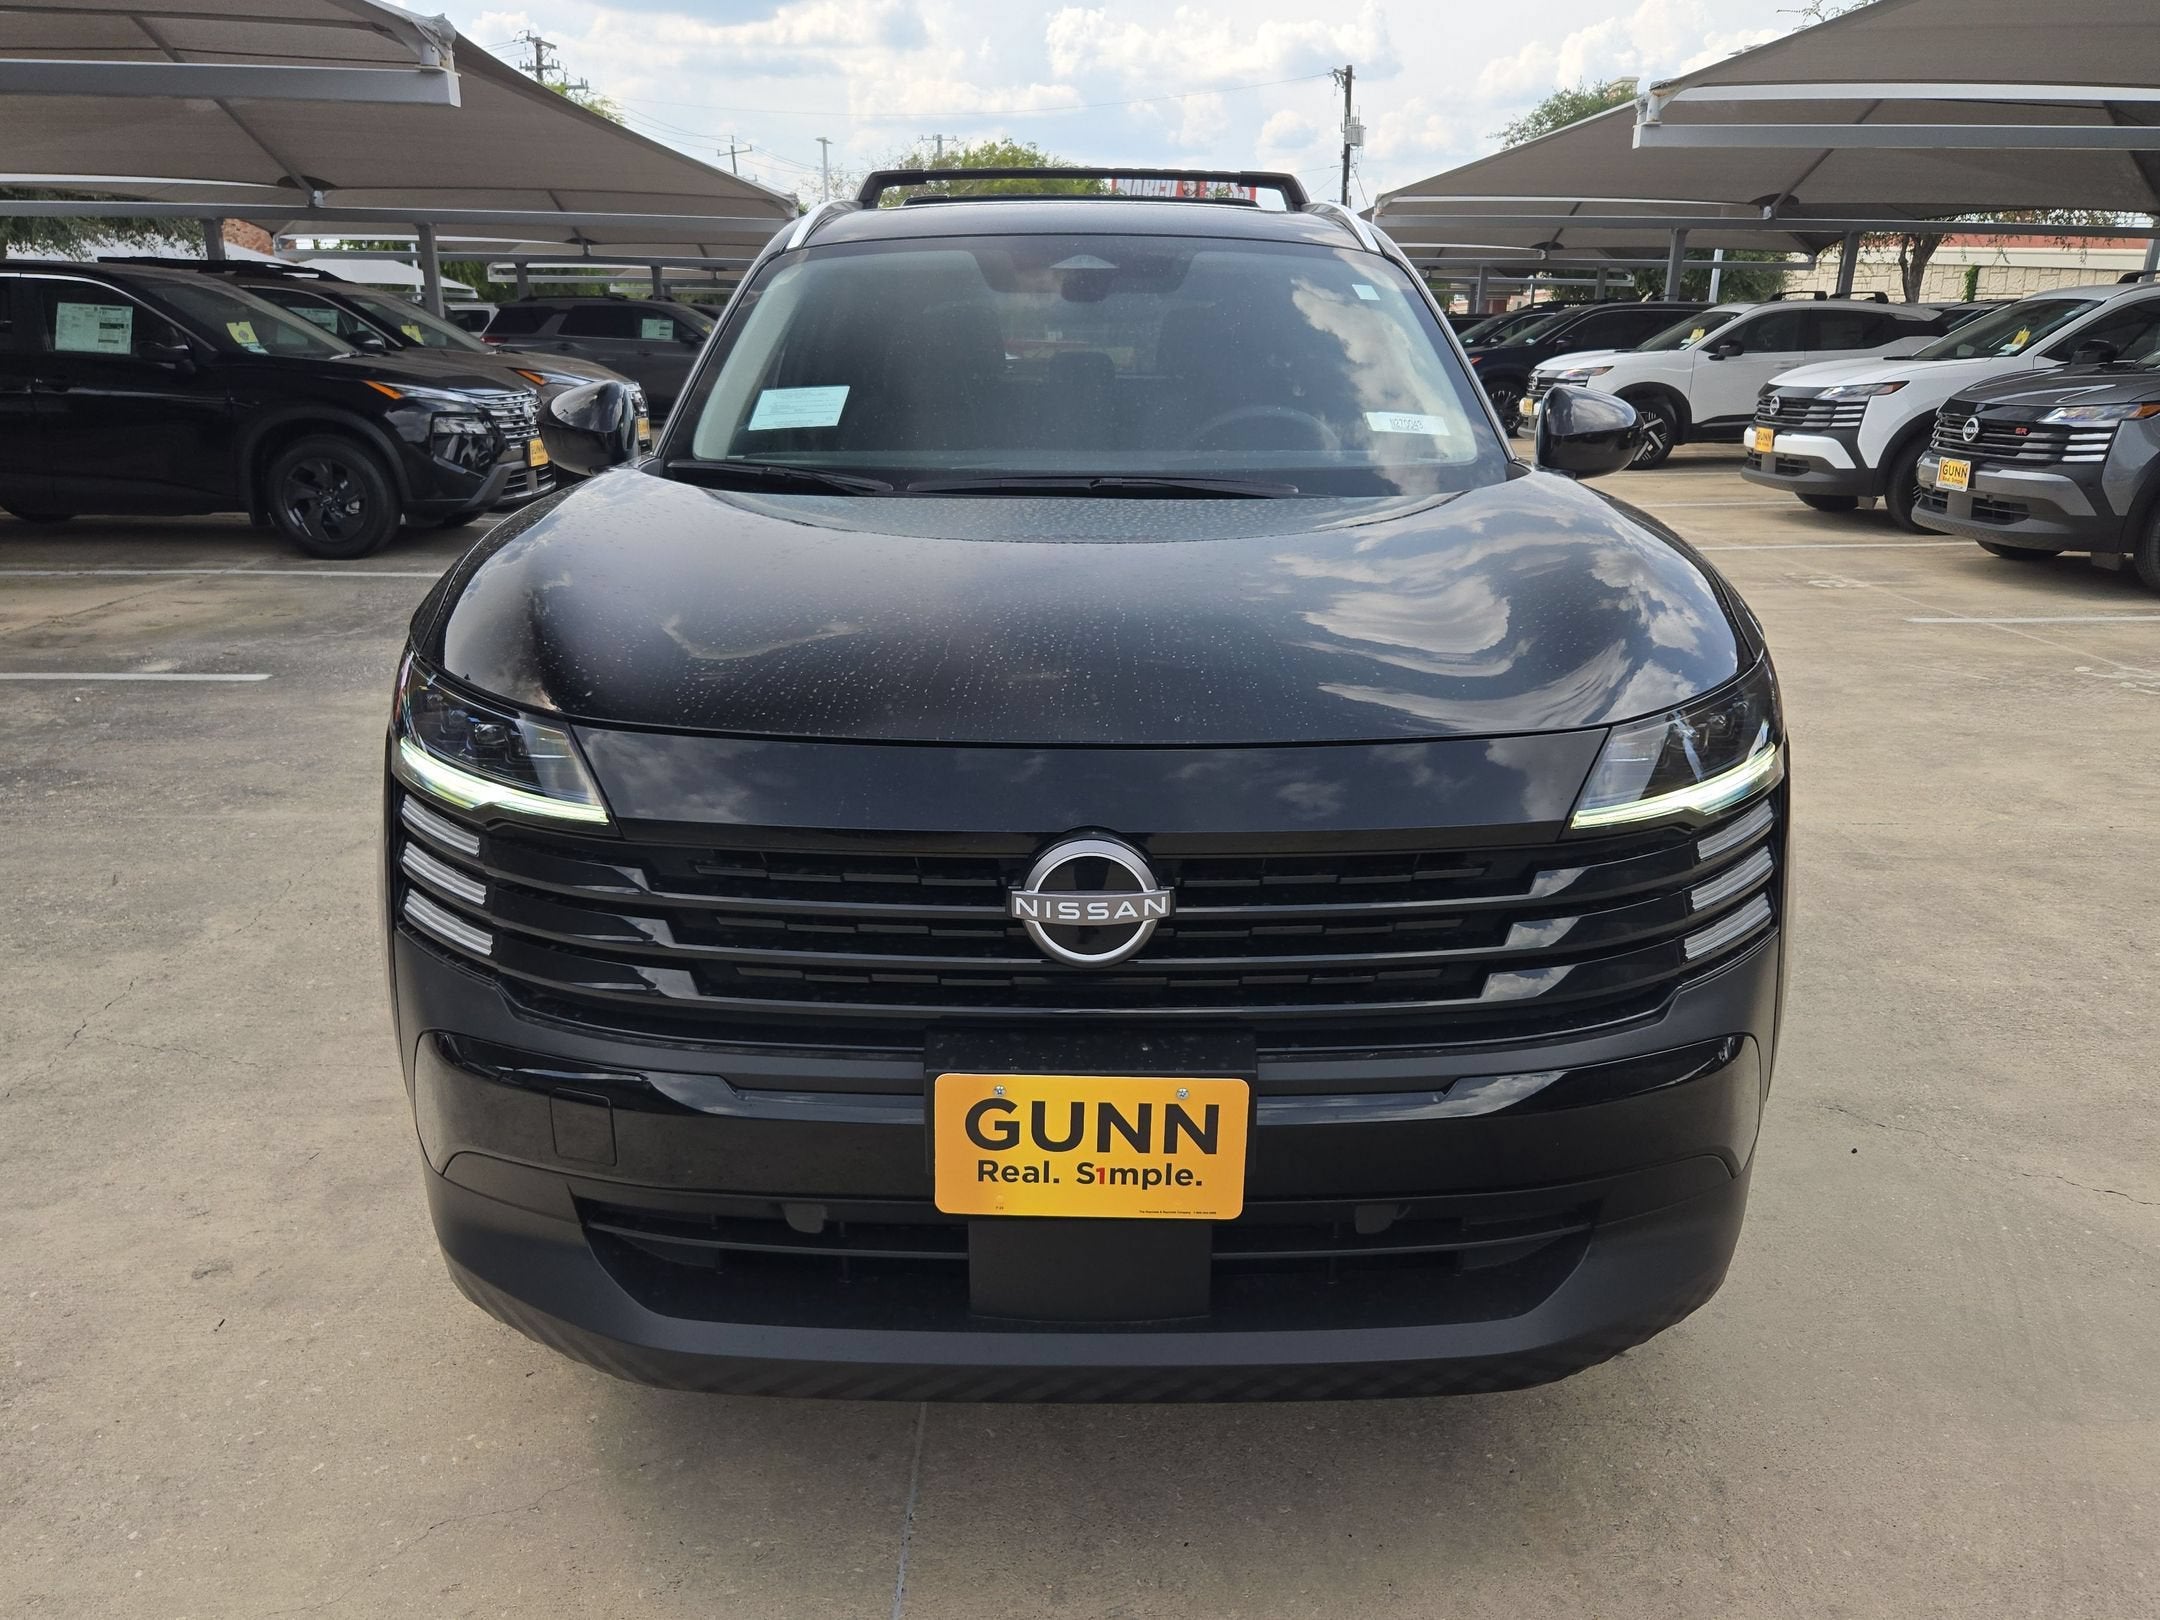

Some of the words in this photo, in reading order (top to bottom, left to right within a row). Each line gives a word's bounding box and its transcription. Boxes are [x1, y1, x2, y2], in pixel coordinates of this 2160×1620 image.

[1942, 464, 1968, 479] GUNN
[1015, 896, 1167, 920] NISSAN
[964, 1097, 1220, 1155] GUNN
[977, 1159, 1060, 1184] Real.
